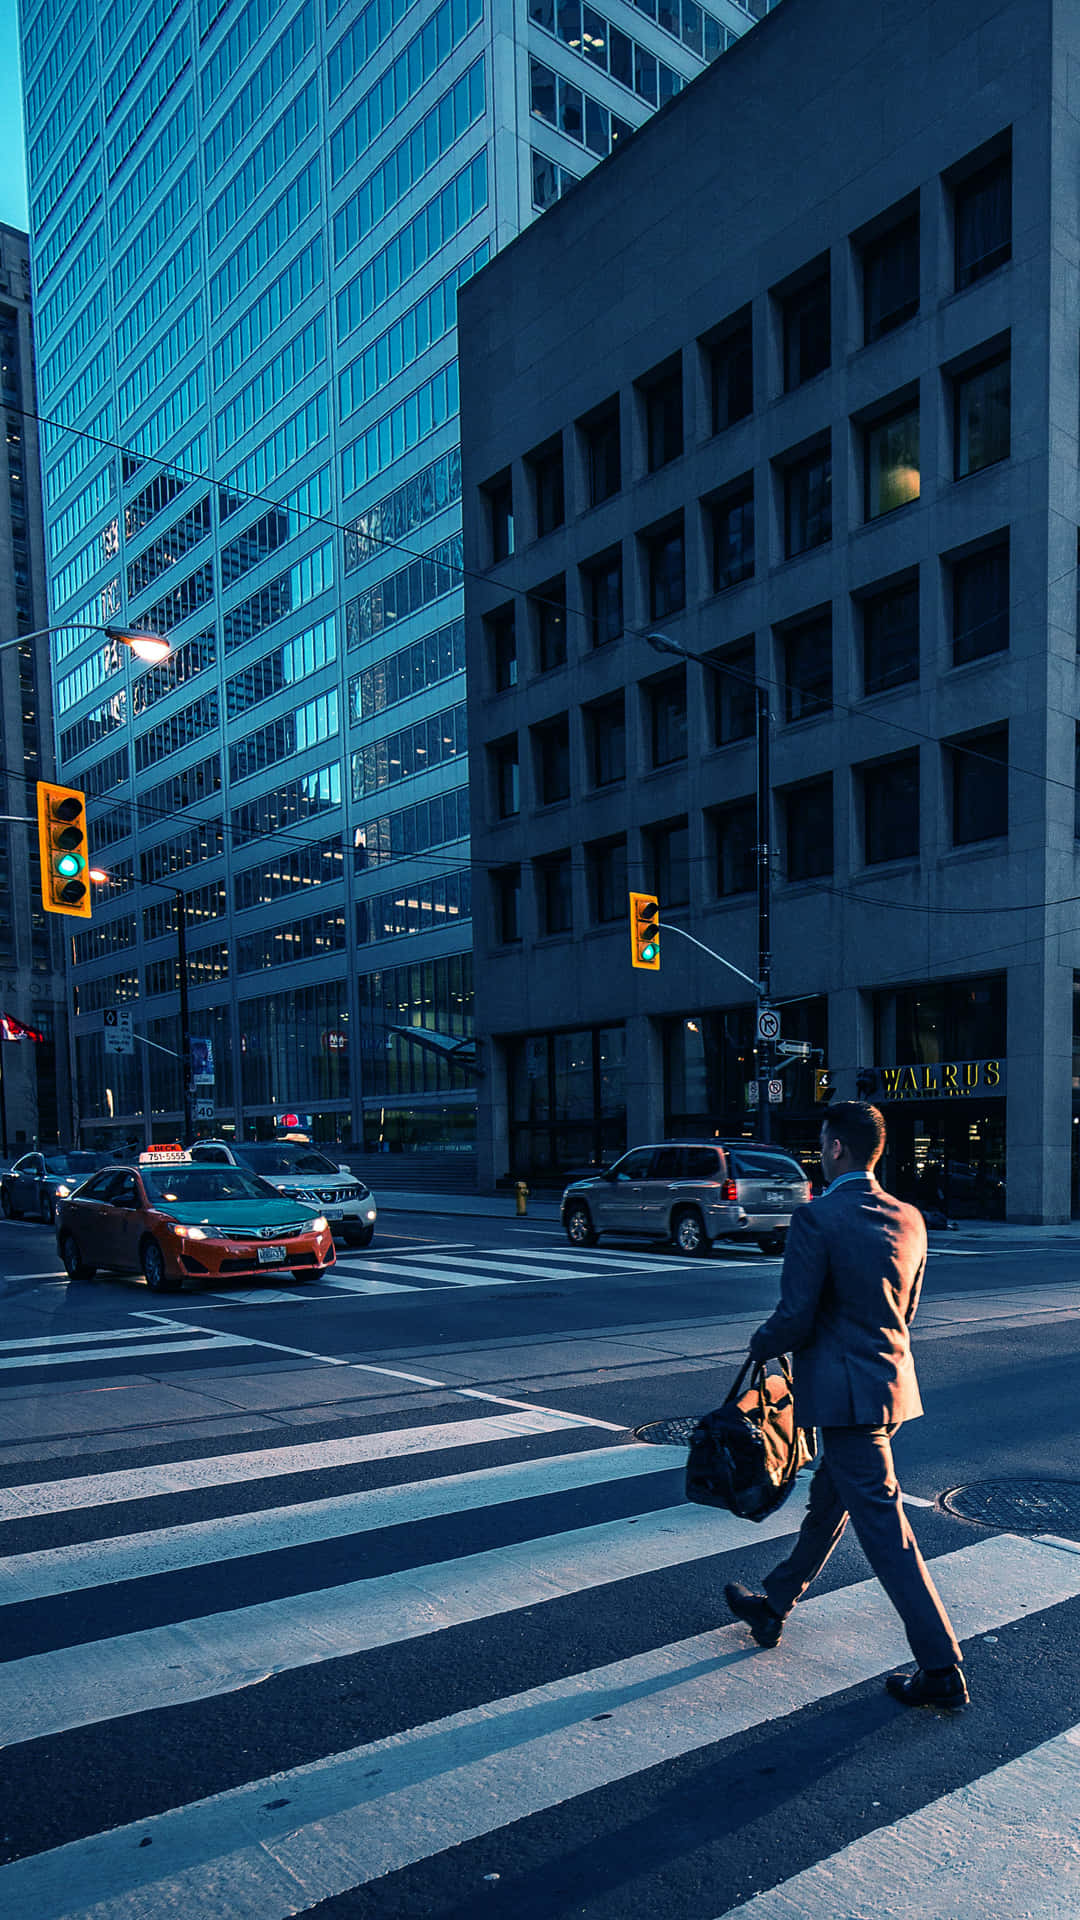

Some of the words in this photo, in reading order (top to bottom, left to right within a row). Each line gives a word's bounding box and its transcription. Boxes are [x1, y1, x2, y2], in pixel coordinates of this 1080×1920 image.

[881, 1061, 1001, 1092] WALRUS
[198, 1107, 213, 1117] 40
[148, 1153, 186, 1161] 751-5555
